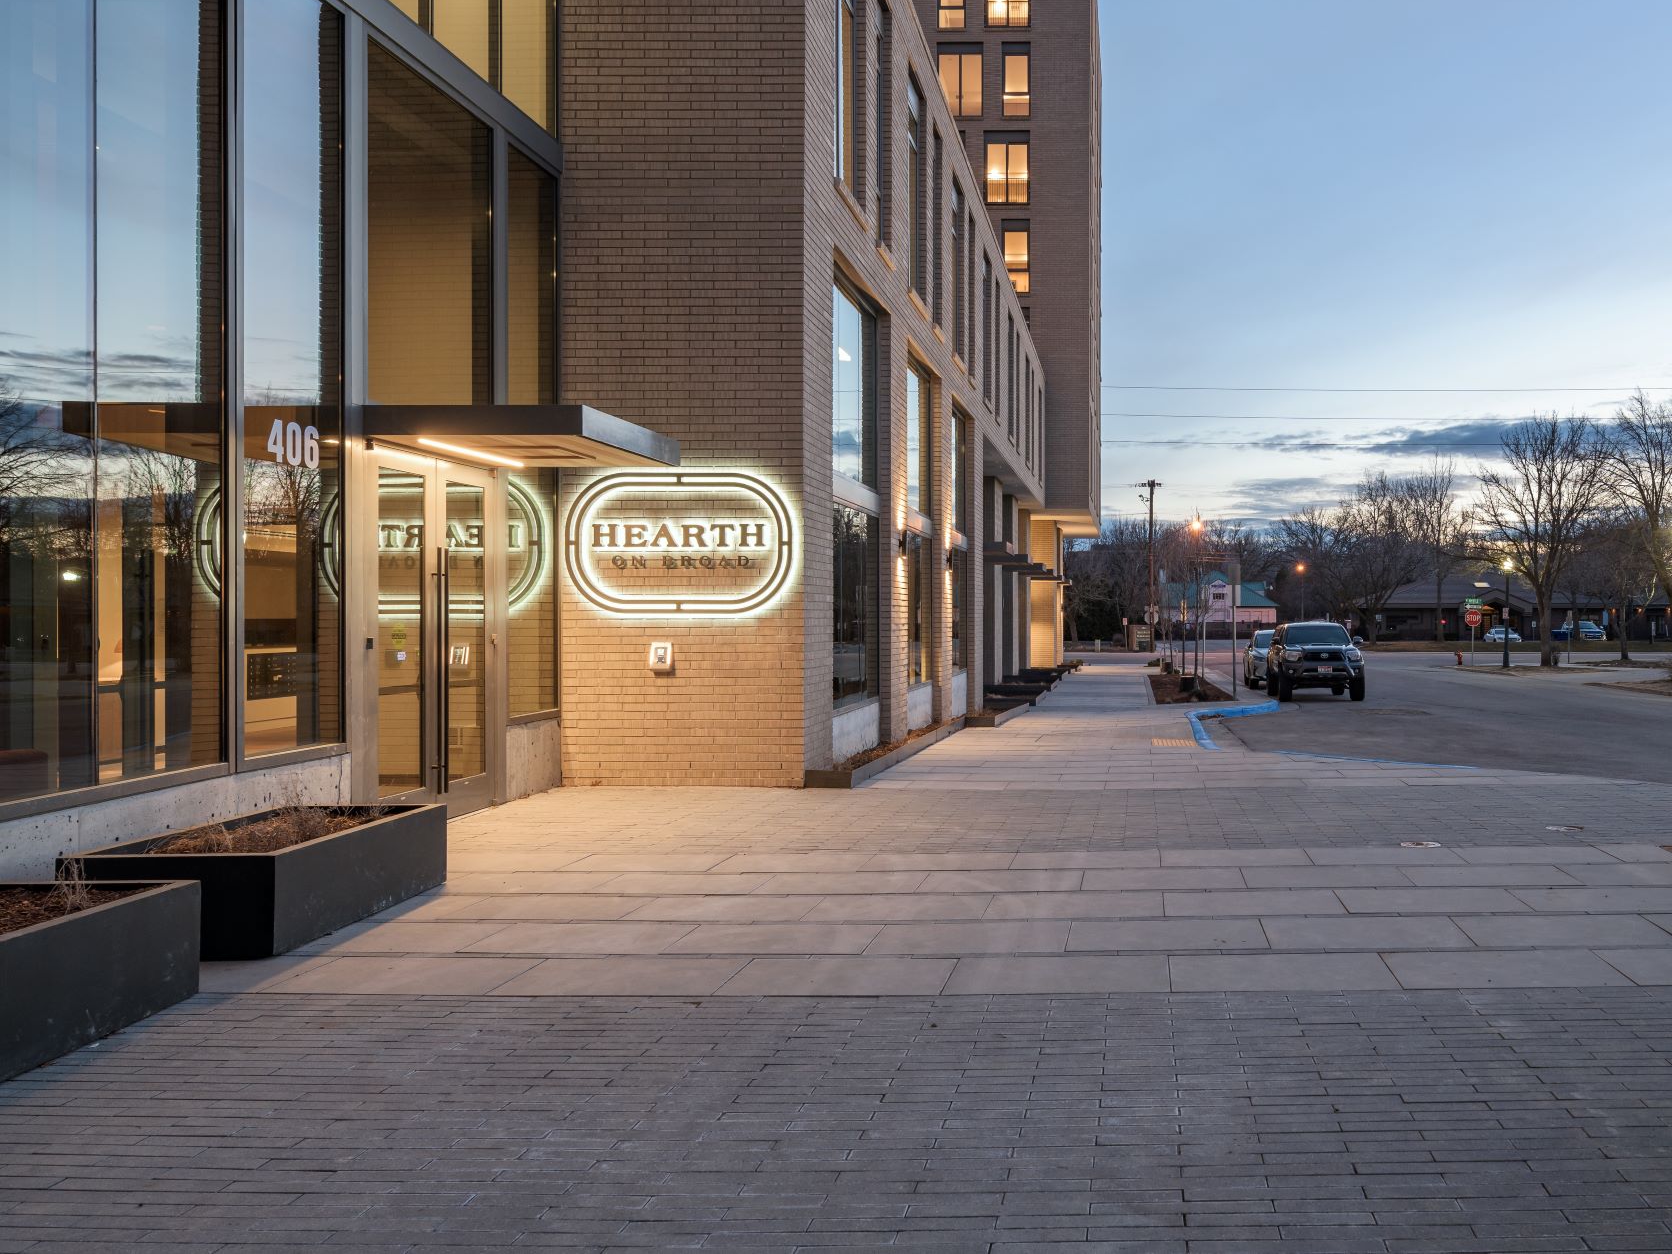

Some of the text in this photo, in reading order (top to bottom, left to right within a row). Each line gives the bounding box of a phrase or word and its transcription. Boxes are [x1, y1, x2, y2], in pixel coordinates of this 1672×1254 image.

[268, 419, 319, 469] 406
[592, 523, 765, 547] HEARTH
[612, 555, 750, 567] ON BROAD
[1466, 614, 1480, 622] STOP
